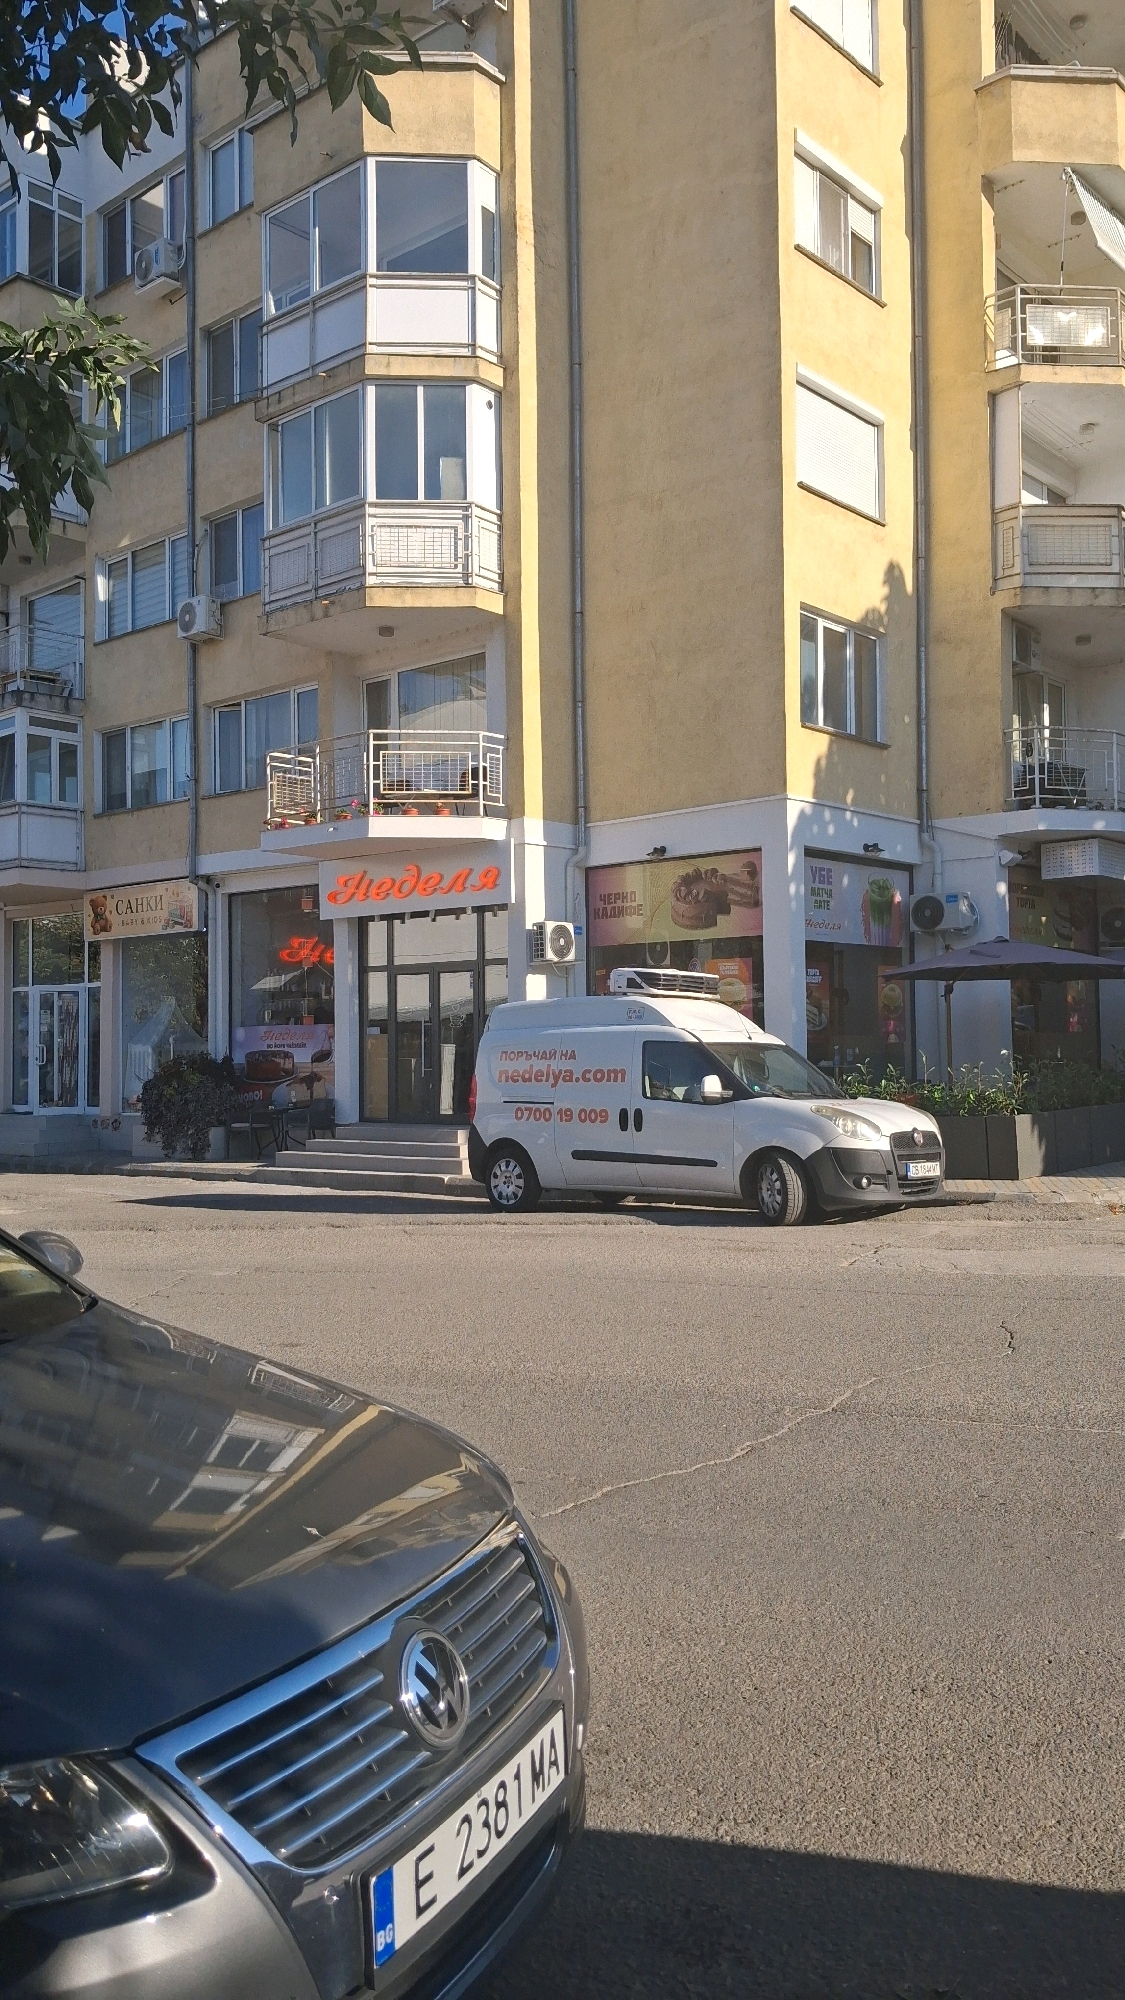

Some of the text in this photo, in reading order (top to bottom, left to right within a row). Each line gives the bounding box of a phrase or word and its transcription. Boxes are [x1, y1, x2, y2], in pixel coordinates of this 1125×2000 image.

[810, 865, 833, 886] УБЕ
[327, 864, 501, 904] Неделя
[599, 890, 637, 906] ЧЕРНО
[810, 886, 833, 899] МАТЧА
[115, 894, 164, 916] САНКИ
[593, 904, 644, 920] КАДИФЕ
[122, 918, 138, 927] BABY
[147, 916, 162, 924] KIDS
[805, 918, 842, 931] Неделя
[260, 1028, 315, 1042] Неделя
[500, 1048, 577, 1061] ПОРЪЧАЙ НА
[497, 1064, 627, 1089] nedelya.com
[514, 1107, 609, 1124] 0700 19 009
[413, 1726, 561, 1920] E 2381 MA
[376, 1922, 394, 1952] BG
